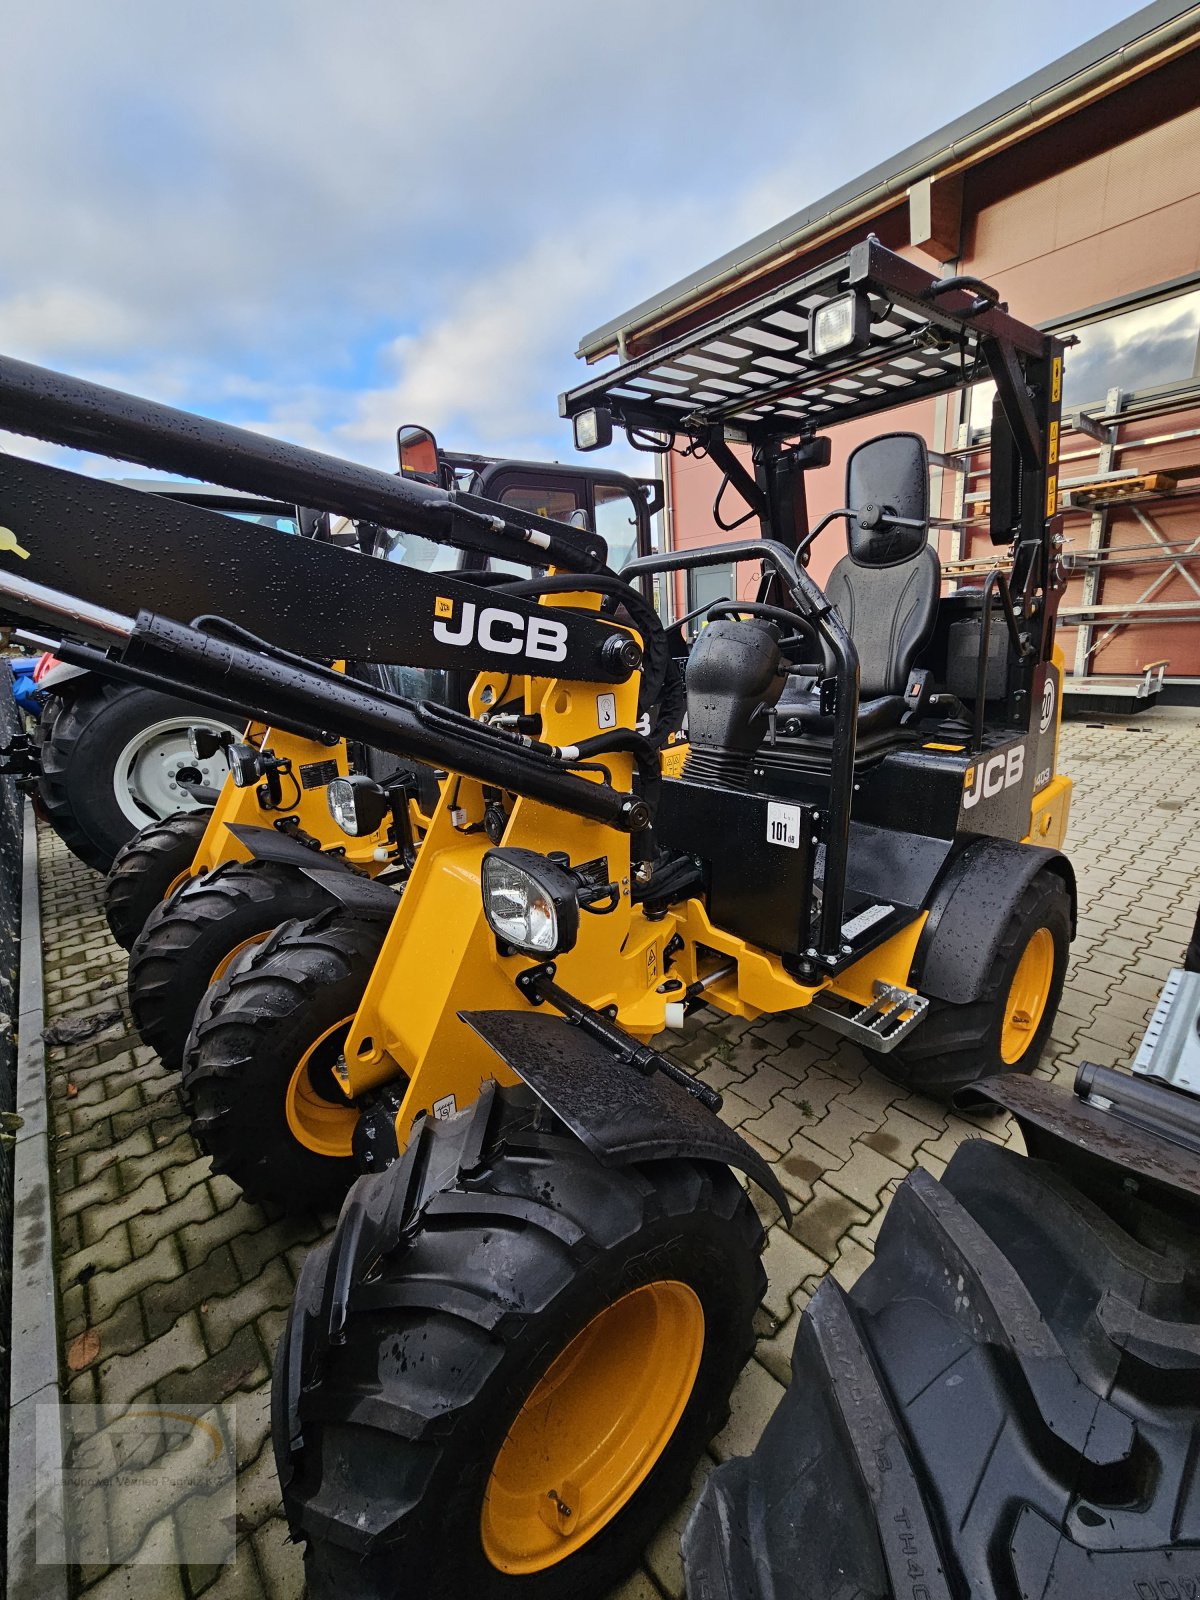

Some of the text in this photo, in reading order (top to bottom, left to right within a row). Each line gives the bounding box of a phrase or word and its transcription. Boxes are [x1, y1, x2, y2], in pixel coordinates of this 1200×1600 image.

[433, 602, 568, 662] JCB
[1040, 691, 1052, 720] 20
[963, 744, 1025, 809] JCB
[771, 821, 787, 842] 101
